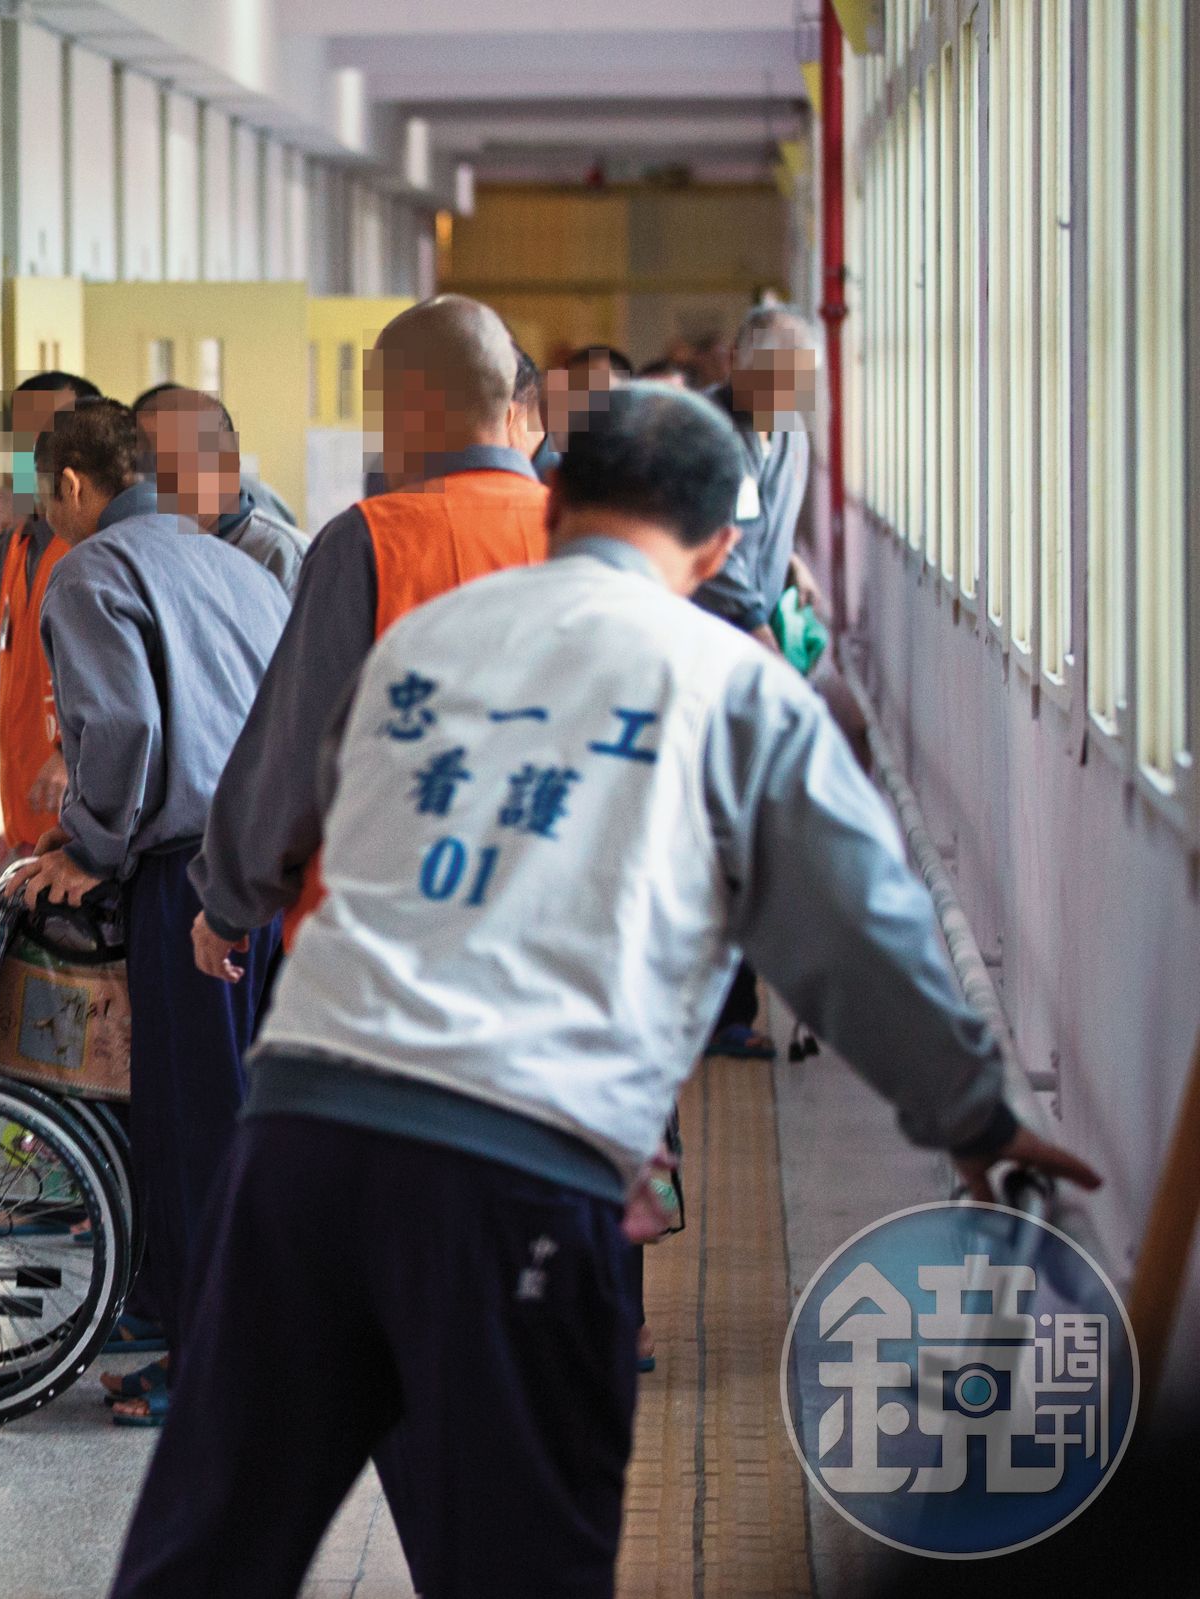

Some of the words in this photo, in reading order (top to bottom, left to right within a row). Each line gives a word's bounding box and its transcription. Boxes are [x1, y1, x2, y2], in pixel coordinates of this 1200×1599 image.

[380, 671, 659, 765] 忠一工
[411, 745, 583, 840] 看護
[418, 836, 500, 907] 01
